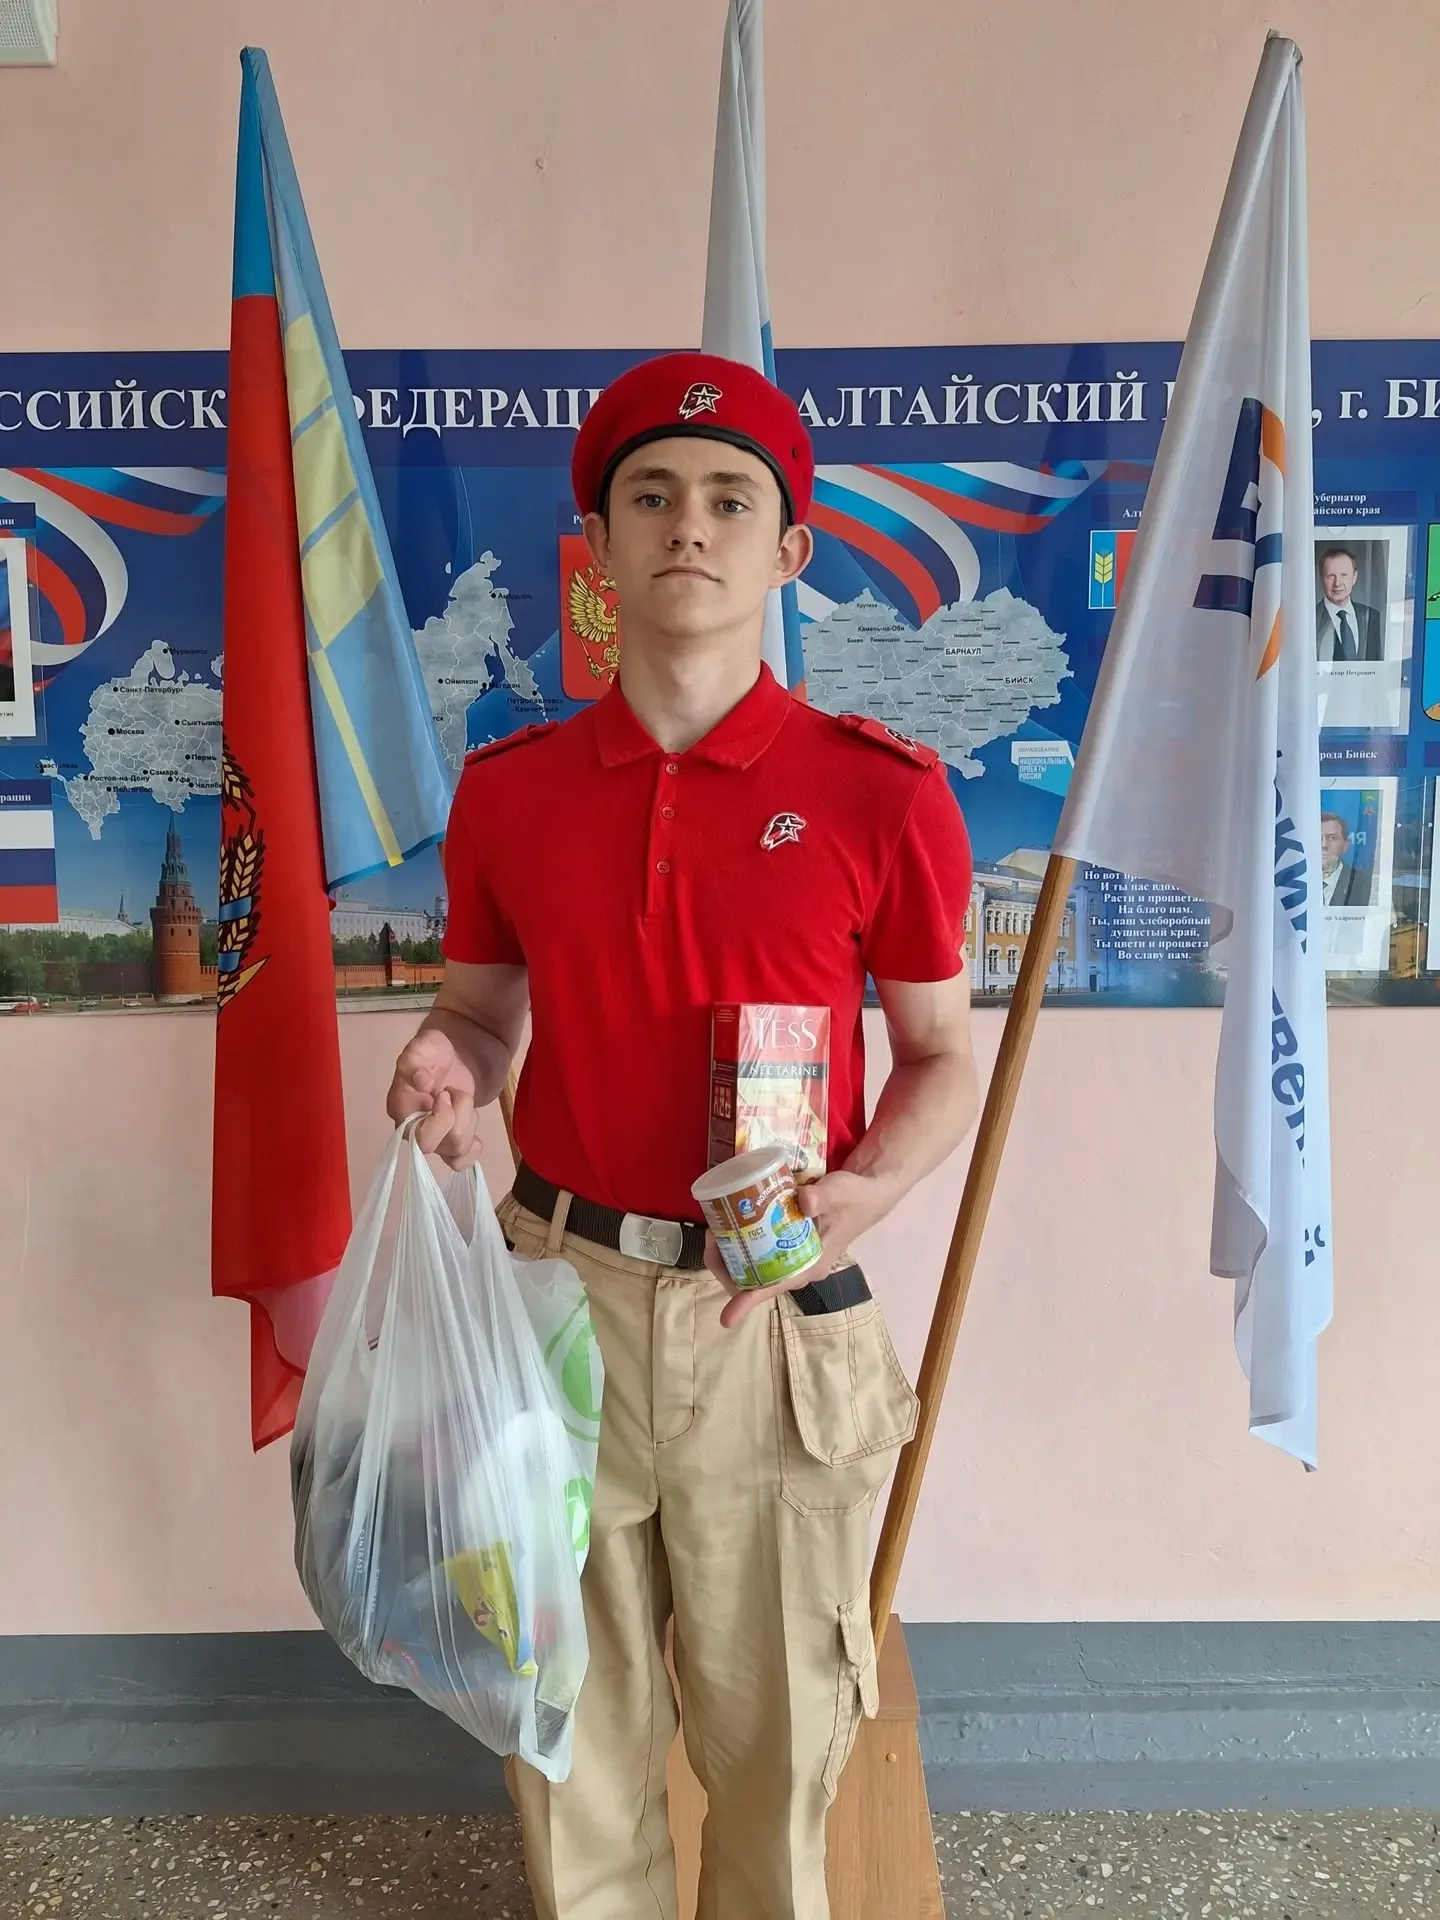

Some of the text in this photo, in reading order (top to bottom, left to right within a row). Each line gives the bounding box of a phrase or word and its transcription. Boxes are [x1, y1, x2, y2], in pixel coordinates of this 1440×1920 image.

[798, 370, 1147, 427] АЛТАЙСКИЙ
[1339, 390, 1369, 420] г.
[1313, 492, 1367, 504] убернатор
[1356, 507, 1380, 516] края
[1005, 676, 1034, 684] БИЙСК
[120, 686, 184, 695] Санкт-Петербург
[116, 728, 145, 736] Москва
[191, 754, 217, 762] Пермь
[1345, 749, 1378, 759] Бийск
[150, 769, 178, 777] Самара
[90, 775, 150, 784] Ростов-на-Дону
[175, 776, 191, 784] Уфа
[1084, 870, 1100, 880] Но
[1102, 872, 1120, 880] вот
[1100, 882, 1109, 891] И
[1131, 883, 1149, 891] нас
[1104, 893, 1135, 903] Расти
[1118, 905, 1133, 914] На
[1136, 905, 1166, 914] благо
[1090, 916, 1110, 927] Ты,
[1139, 916, 1211, 927] хлеборобный
[1110, 928, 1200, 938] душистый край,
[1094, 939, 1111, 948] Ты
[1114, 941, 1145, 949] цвети
[1118, 951, 1192, 961] Во славу нам.
[756, 1017, 818, 1052] TESS
[750, 1066, 818, 1077] NECTARINE
[748, 1226, 764, 1238] ГОСТ
